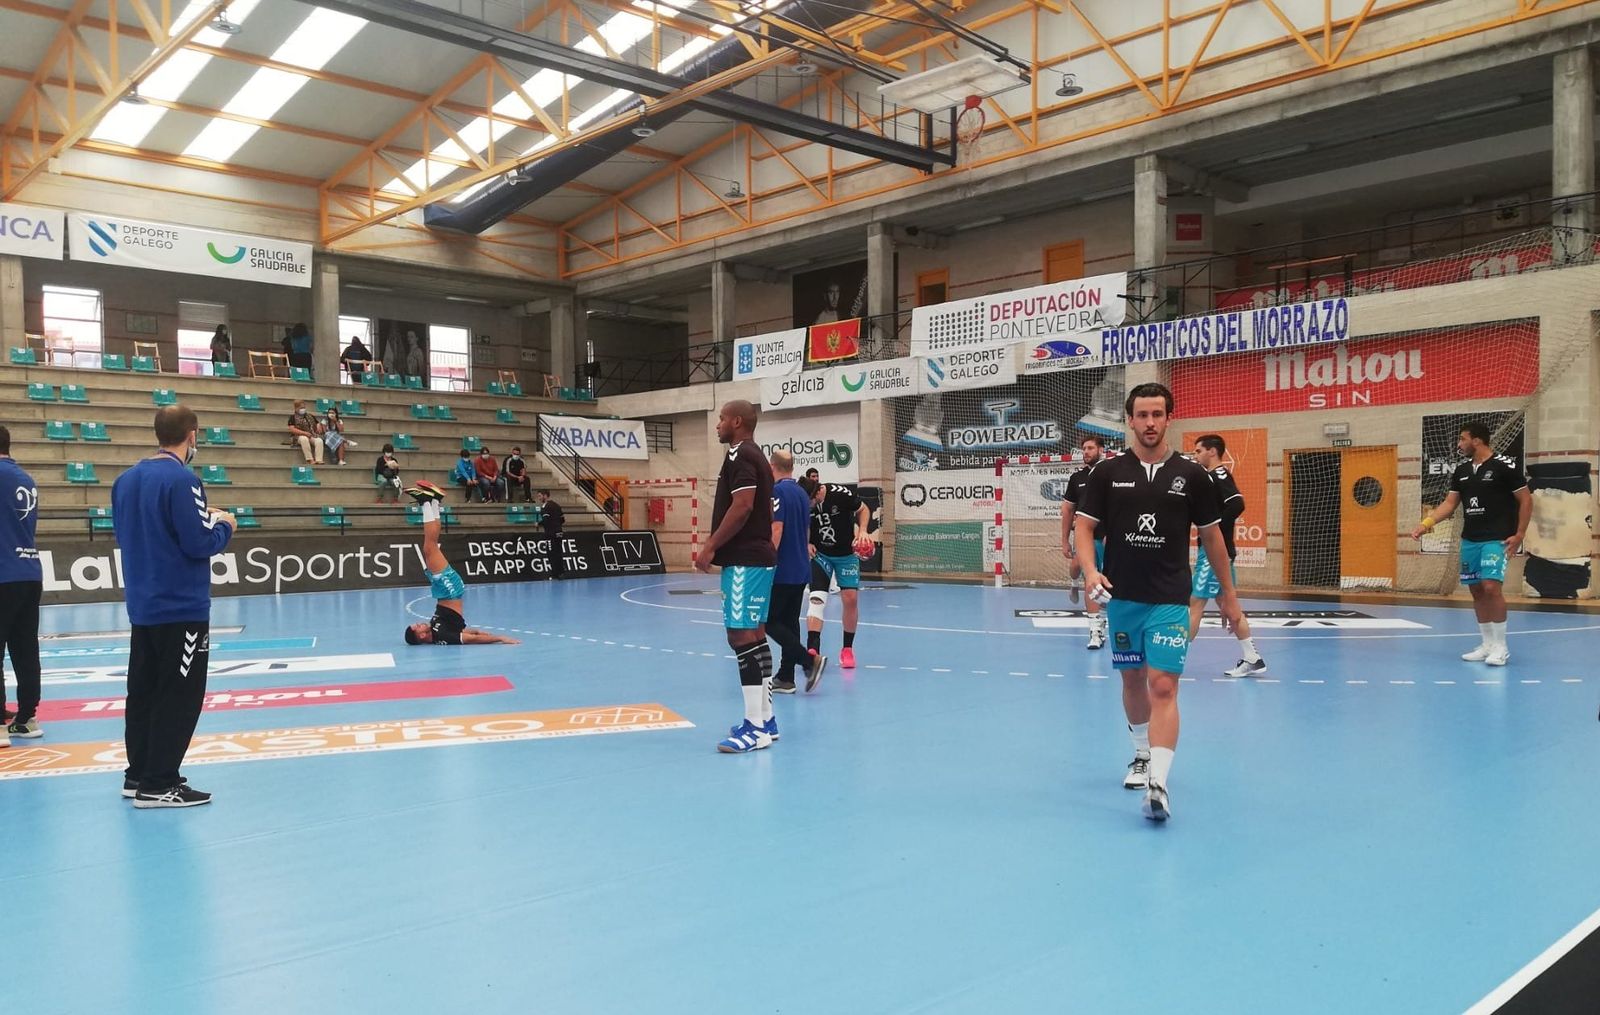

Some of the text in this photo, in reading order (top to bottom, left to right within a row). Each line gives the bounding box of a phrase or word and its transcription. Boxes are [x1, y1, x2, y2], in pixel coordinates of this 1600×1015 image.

[123, 225, 179, 241] DEPORTE
[123, 236, 173, 250] GALEGO
[250, 247, 293, 262] GALICIA
[250, 258, 306, 274] SAUDABLE
[990, 284, 1102, 322] DEPUTACIÓN
[990, 308, 1107, 341] PONTEVEDRA
[1102, 297, 1349, 366] FRIGORIFICOS DEL MORRAZO
[756, 340, 785, 354] XUNTA
[756, 350, 802, 368] DE GALICIA
[950, 348, 1005, 366] DEPORTE
[869, 367, 901, 380] GALICIA
[950, 363, 999, 380] GALEGO
[1263, 342, 1425, 391] Mahou
[770, 375, 824, 406] galicia
[869, 377, 910, 391] SAUDABLE
[1309, 389, 1371, 408] SIN
[556, 427, 641, 449] ABANCA
[950, 423, 1056, 446] POWERADE
[793, 454, 825, 467] hipyard
[950, 454, 980, 467] bebida
[929, 485, 995, 500] CERQUEIR
[815, 513, 831, 526] 13
[617, 540, 643, 559] TV
[465, 556, 588, 576] LA APP GRTIS
